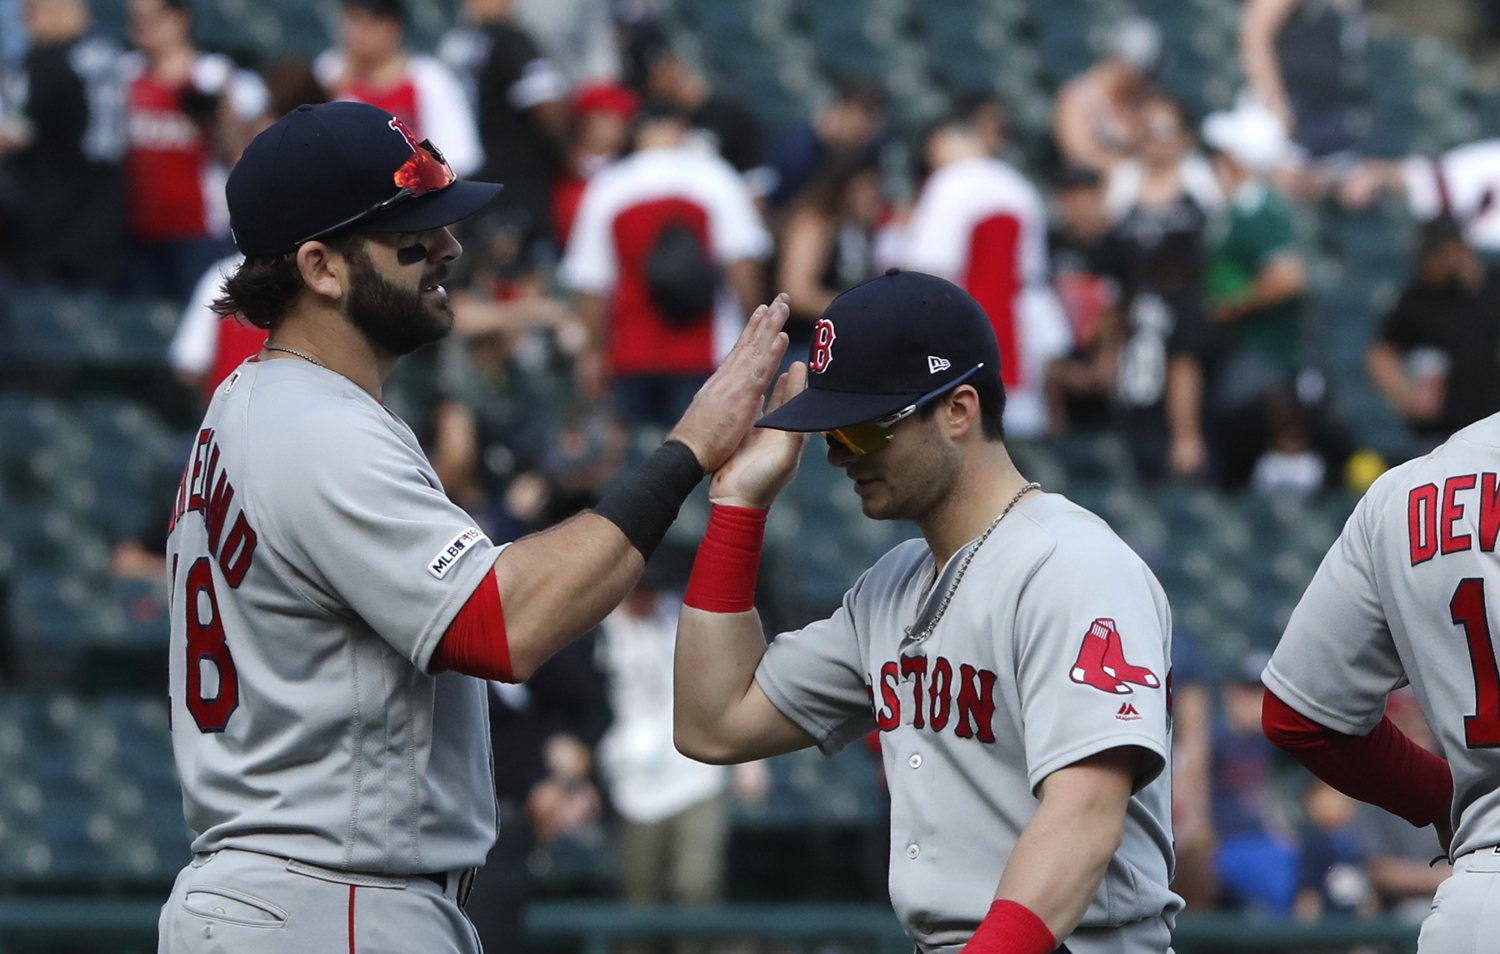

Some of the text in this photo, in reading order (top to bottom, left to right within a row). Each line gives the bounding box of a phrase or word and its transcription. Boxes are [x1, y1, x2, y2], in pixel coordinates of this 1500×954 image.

[809, 319, 836, 374] B
[432, 546, 459, 574] MLB
[171, 553, 240, 734] 8
[866, 652, 998, 744] STON
